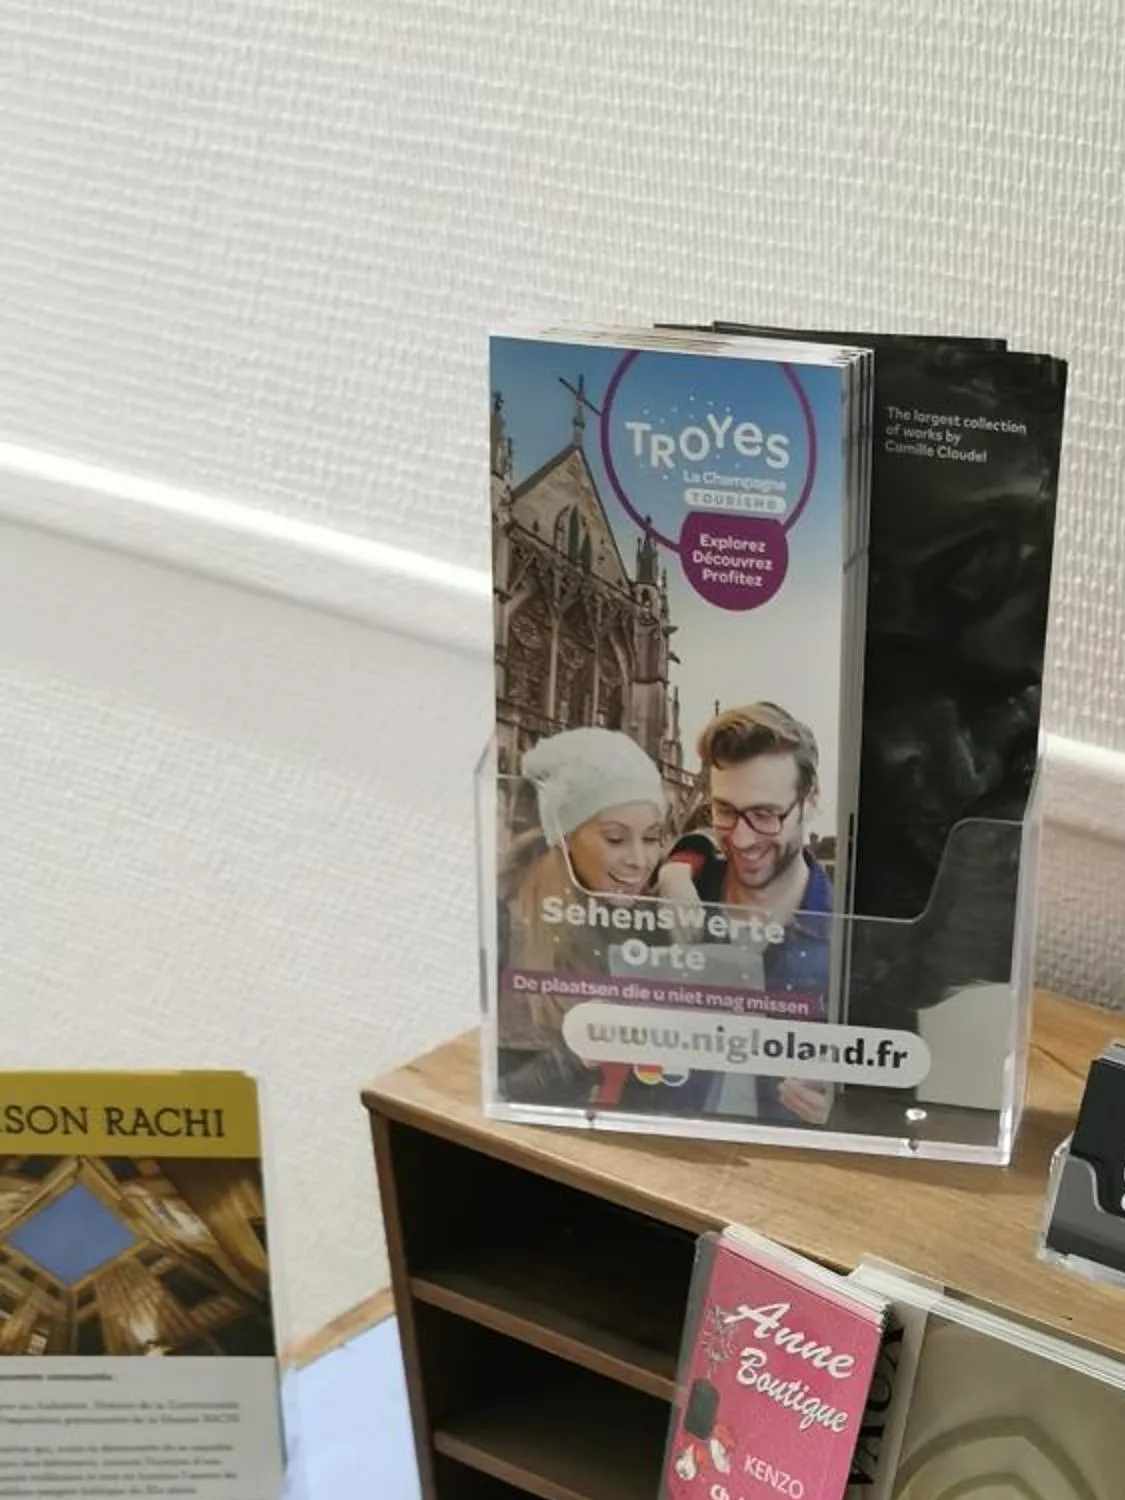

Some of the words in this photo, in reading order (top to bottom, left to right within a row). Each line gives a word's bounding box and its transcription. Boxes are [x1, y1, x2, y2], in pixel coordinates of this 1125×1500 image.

[886, 406, 911, 420] The
[913, 410, 960, 427] largest
[963, 417, 1027, 434] collection
[885, 424, 901, 435] of
[903, 428, 943, 441] works
[945, 430, 962, 446] by
[884, 440, 934, 457] Camille
[937, 445, 987, 463] Claudel
[702, 471, 787, 491] Champagne
[692, 491, 778, 509] TOURISME
[700, 534, 767, 553] Explorez
[693, 549, 773, 570] Découvrez
[702, 568, 764, 587] Profitez
[622, 940, 706, 970] Orte
[512, 975, 538, 991] De
[541, 977, 619, 998] plaatsen
[622, 985, 650, 1000] die
[653, 989, 665, 1001] u
[668, 987, 703, 1005] niet
[706, 992, 745, 1012] mag
[747, 996, 809, 1016] missen
[586, 1024, 909, 1069] www.nigloland.fr
[0, 1104, 89, 1136] SON
[104, 1107, 225, 1138] RACHI
[725, 1302, 856, 1379] Anne
[736, 1347, 849, 1433] Boutique
[743, 1455, 804, 1500] KENZO
